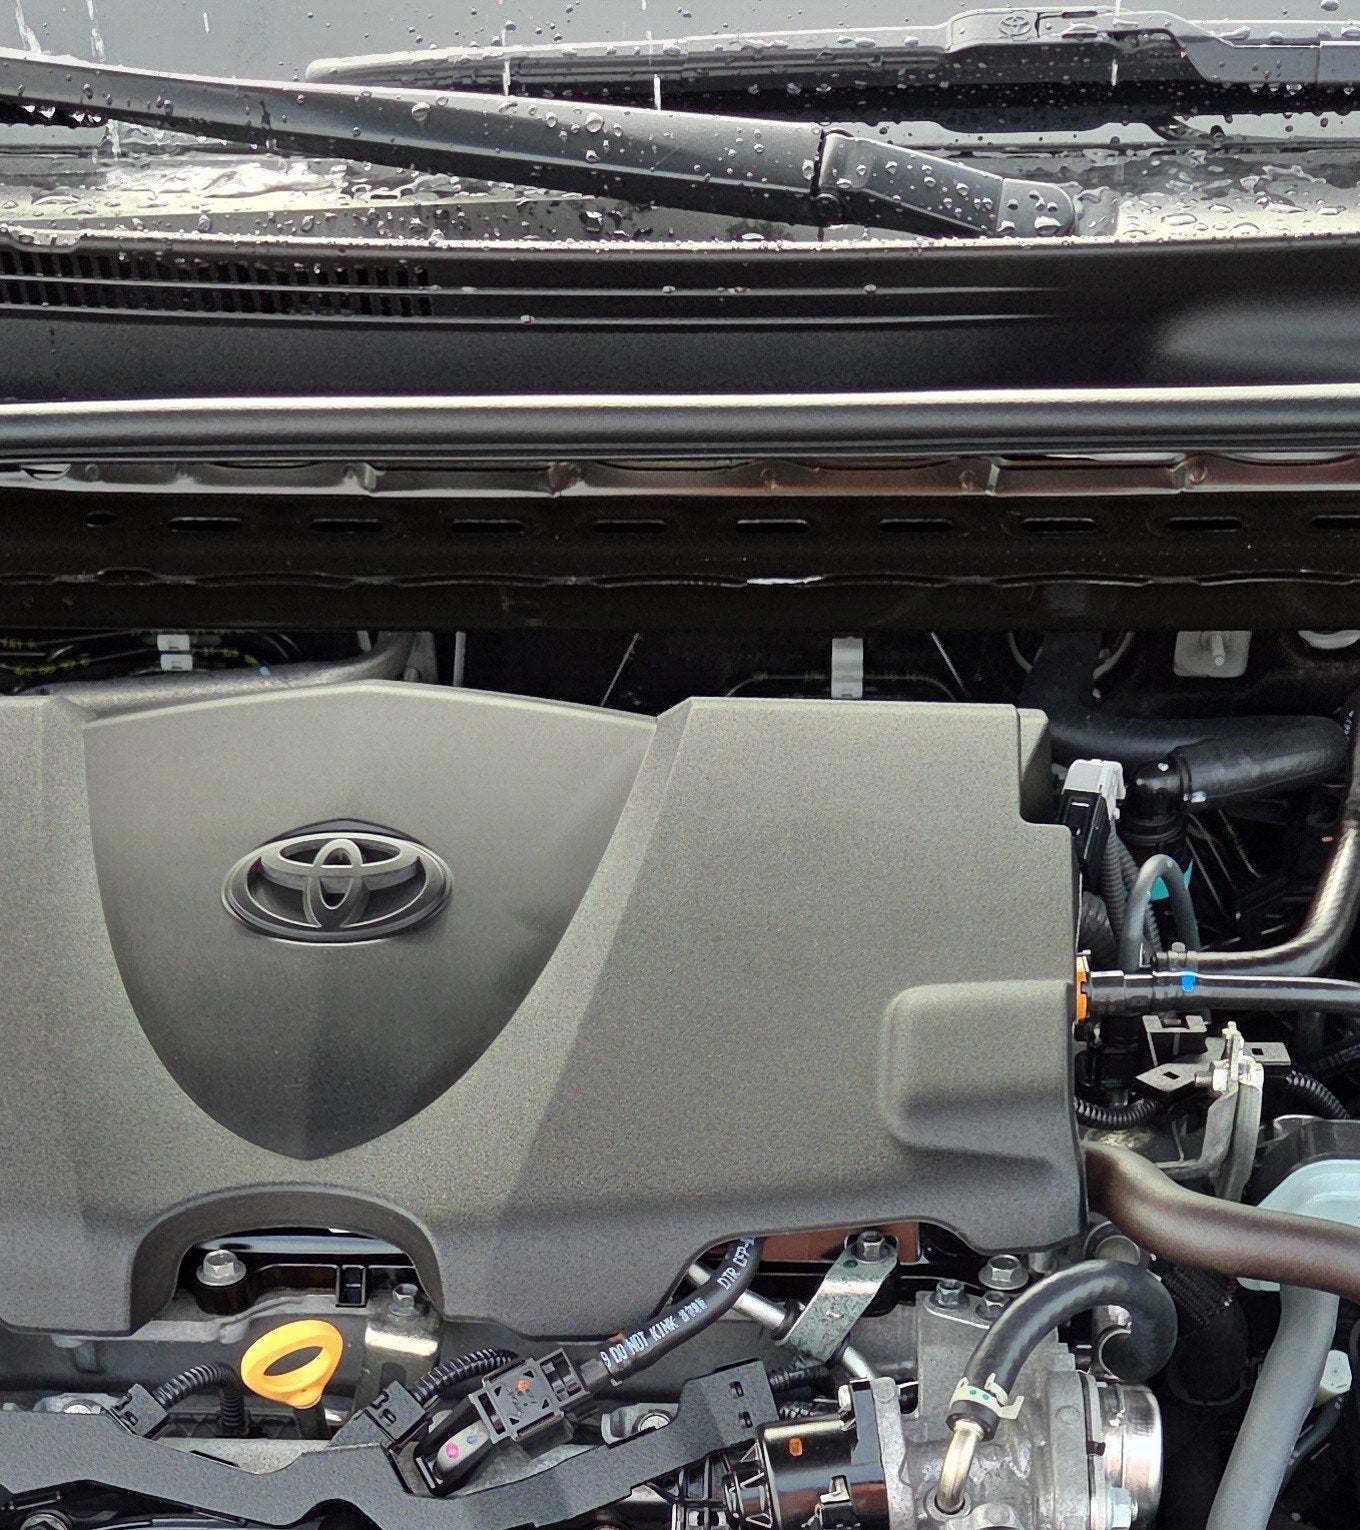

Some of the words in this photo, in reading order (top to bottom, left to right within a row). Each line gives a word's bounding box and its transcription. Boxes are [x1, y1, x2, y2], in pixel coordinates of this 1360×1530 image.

[609, 1343, 628, 1363] DO
[625, 1331, 649, 1355] NOT
[649, 1316, 680, 1341] KINK
[717, 1267, 740, 1290] DTR
